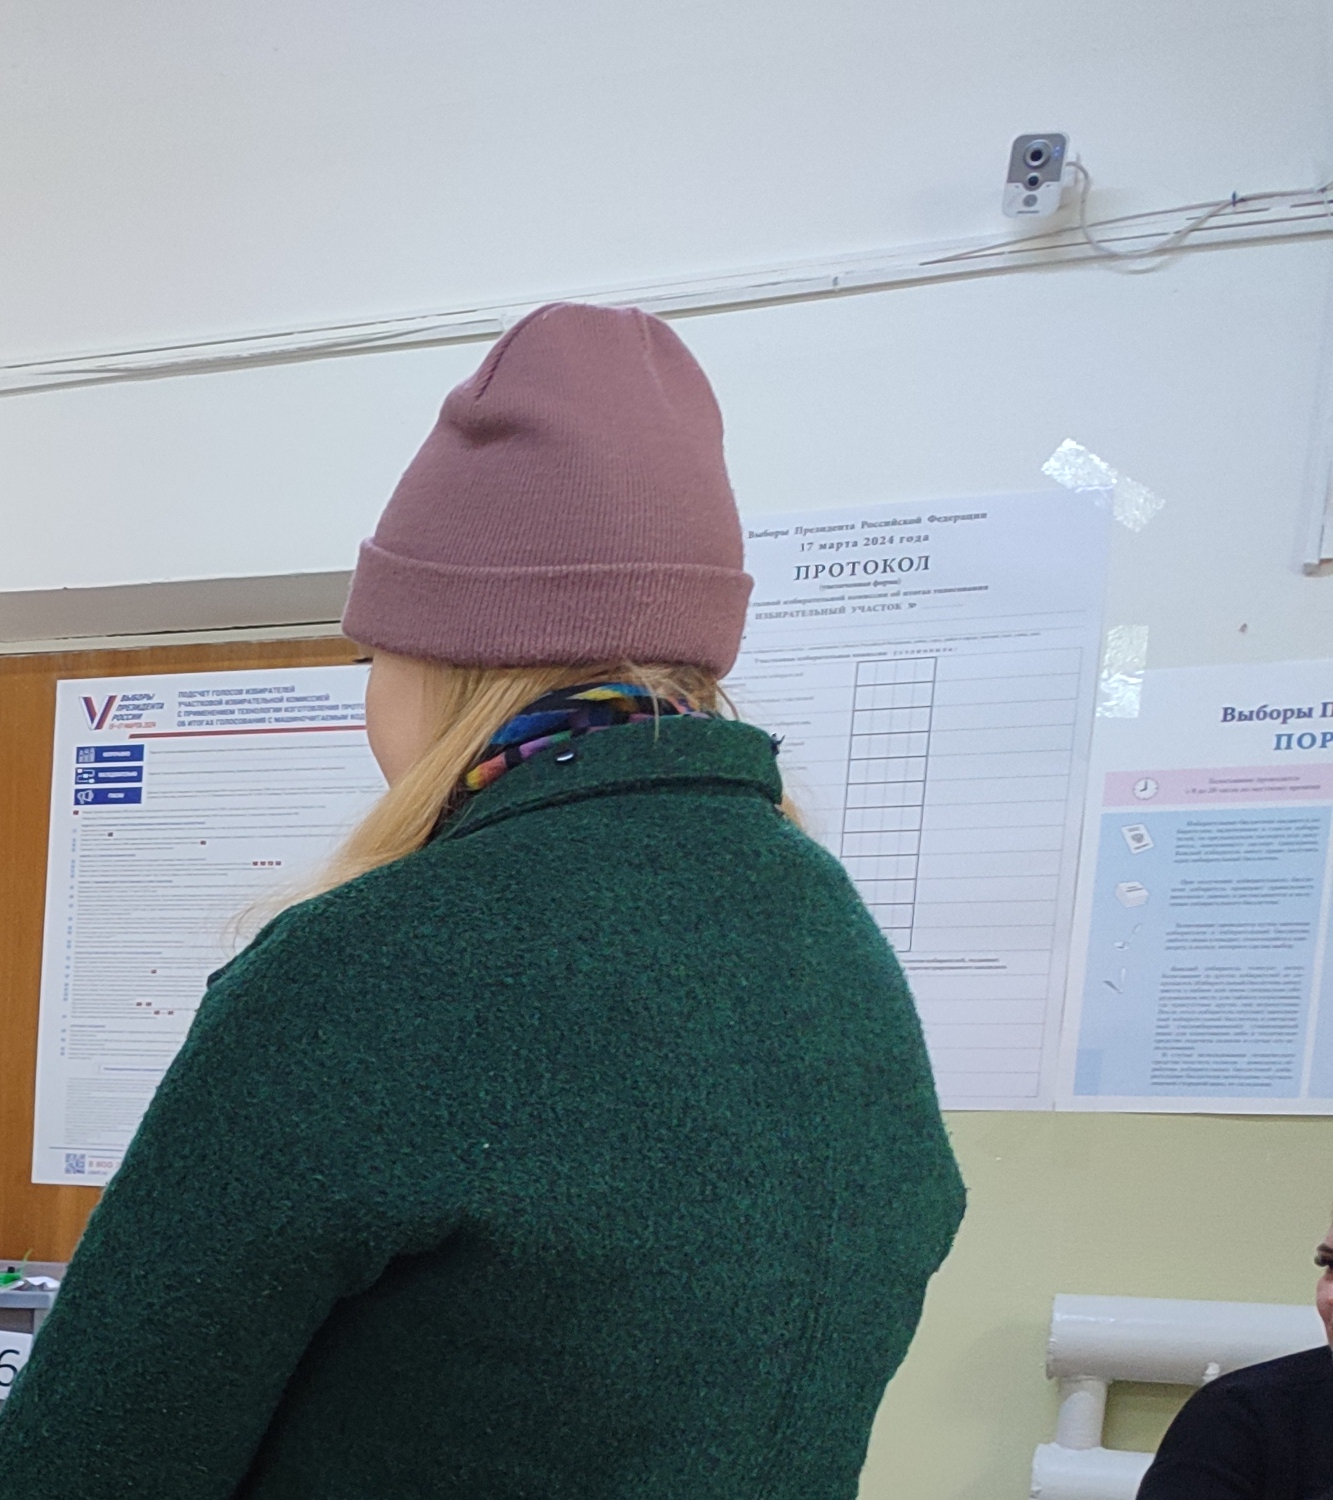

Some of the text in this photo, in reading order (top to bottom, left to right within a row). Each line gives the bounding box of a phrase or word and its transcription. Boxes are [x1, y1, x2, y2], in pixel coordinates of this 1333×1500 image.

[794, 522, 855, 536] Президента
[861, 516, 922, 530] Российской
[927, 512, 988, 525] Федерации
[799, 533, 930, 553] 17 марта 2024 года
[793, 555, 931, 581] ПРОТОКОЛ
[755, 604, 846, 620] ИЗБИРАТЕЛЬНЫЙ
[851, 602, 902, 615] УЧАСТОК
[1221, 704, 1315, 725] Выборы
[1274, 731, 1333, 751] ПОР
